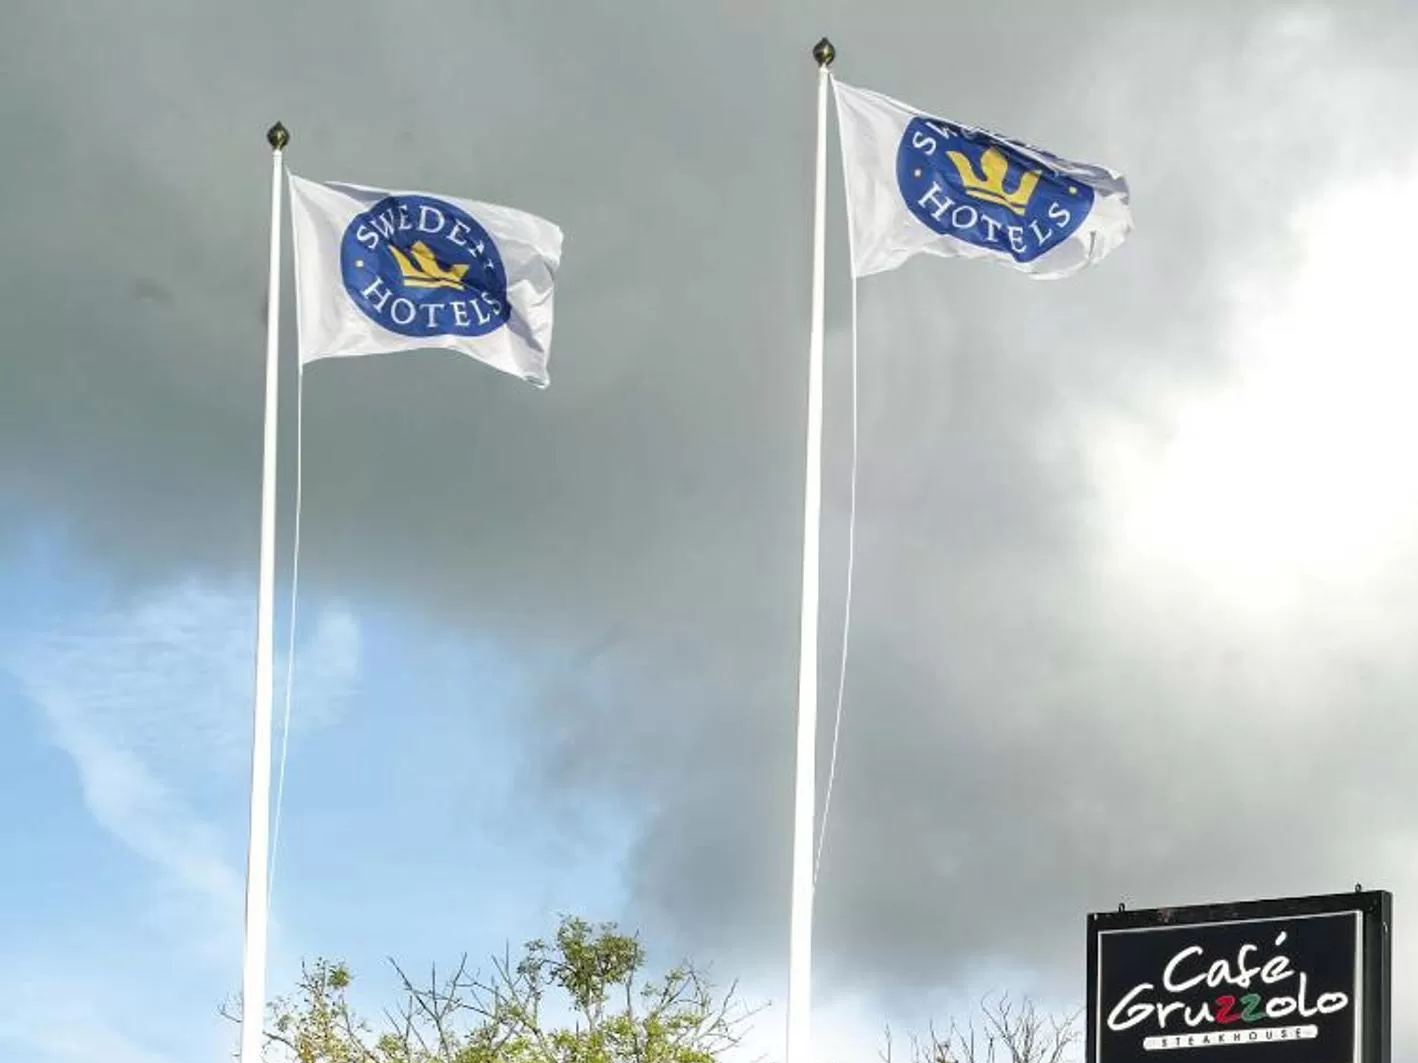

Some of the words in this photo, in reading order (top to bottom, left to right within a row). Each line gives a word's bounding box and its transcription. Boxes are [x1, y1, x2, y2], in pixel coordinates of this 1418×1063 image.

[917, 181, 1071, 253] HOTELS
[361, 276, 503, 327] HOTELS
[1163, 931, 1294, 992] Café
[1107, 972, 1348, 1031] Gruzzolo
[1161, 1028, 1303, 1048] STEAKHOUSE
